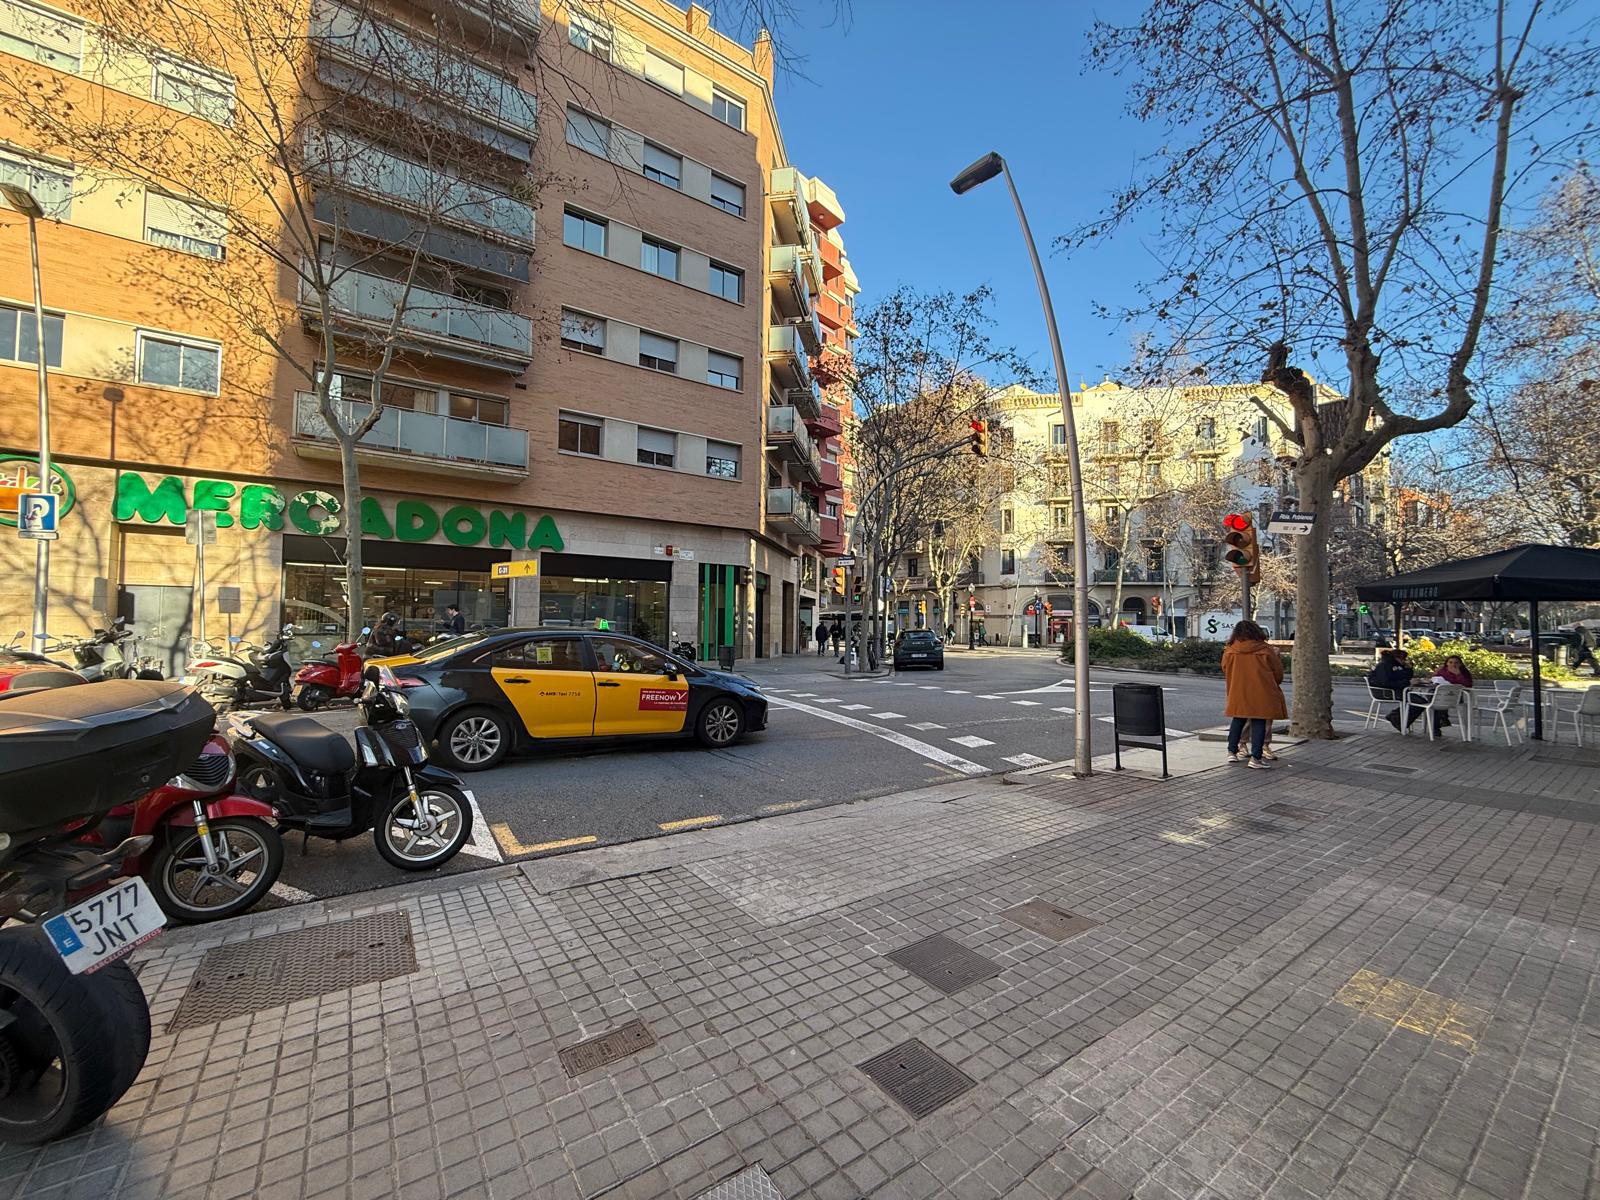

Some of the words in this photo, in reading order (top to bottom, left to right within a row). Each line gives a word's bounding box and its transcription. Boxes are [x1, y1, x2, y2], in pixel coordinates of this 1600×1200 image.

[113, 472, 565, 552] MERCADONA
[70, 882, 138, 934] 5777
[63, 937, 75, 949] E
[86, 944, 136, 974] BARCELONA
[135, 927, 163, 947] MOTOS
[92, 912, 139, 956] JNT
